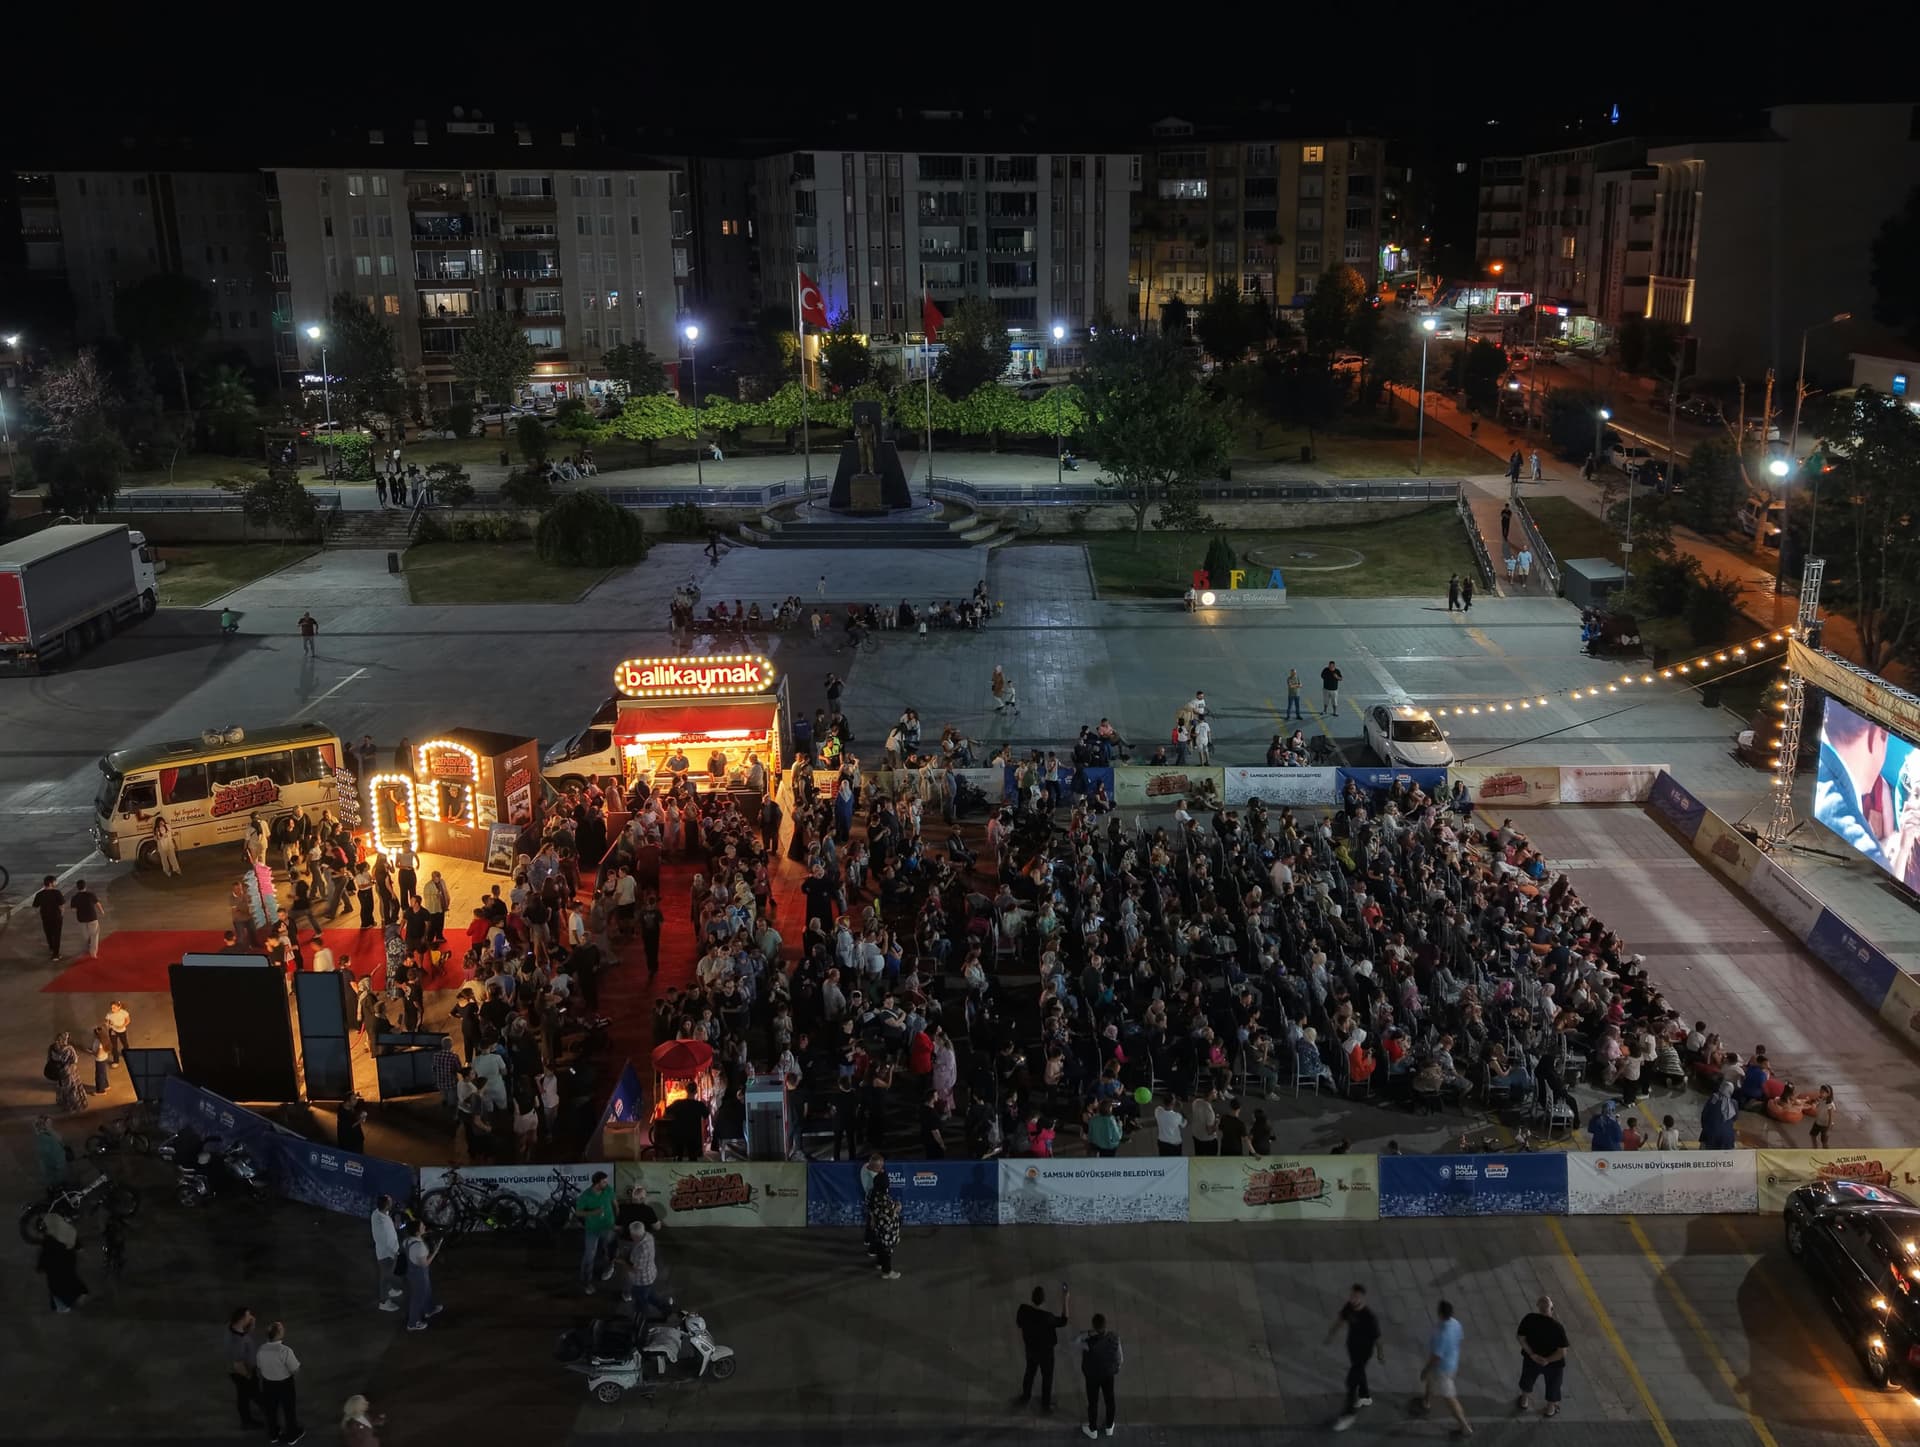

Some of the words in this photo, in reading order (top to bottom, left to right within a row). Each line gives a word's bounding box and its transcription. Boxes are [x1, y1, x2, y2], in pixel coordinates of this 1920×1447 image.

[1193, 568, 1285, 590] BFRA
[626, 663, 759, 689] ballıkaymak
[1645, 1161, 1691, 1170] BÜYÜKŞEHİR
[1693, 1160, 1734, 1168] BELEDİYESİ
[1075, 1169, 1121, 1179] BÜYÜKŞEHİR
[1123, 1169, 1165, 1178] BELEDİYESİ
[498, 1175, 546, 1184] BÜYÜKŞEHİR
